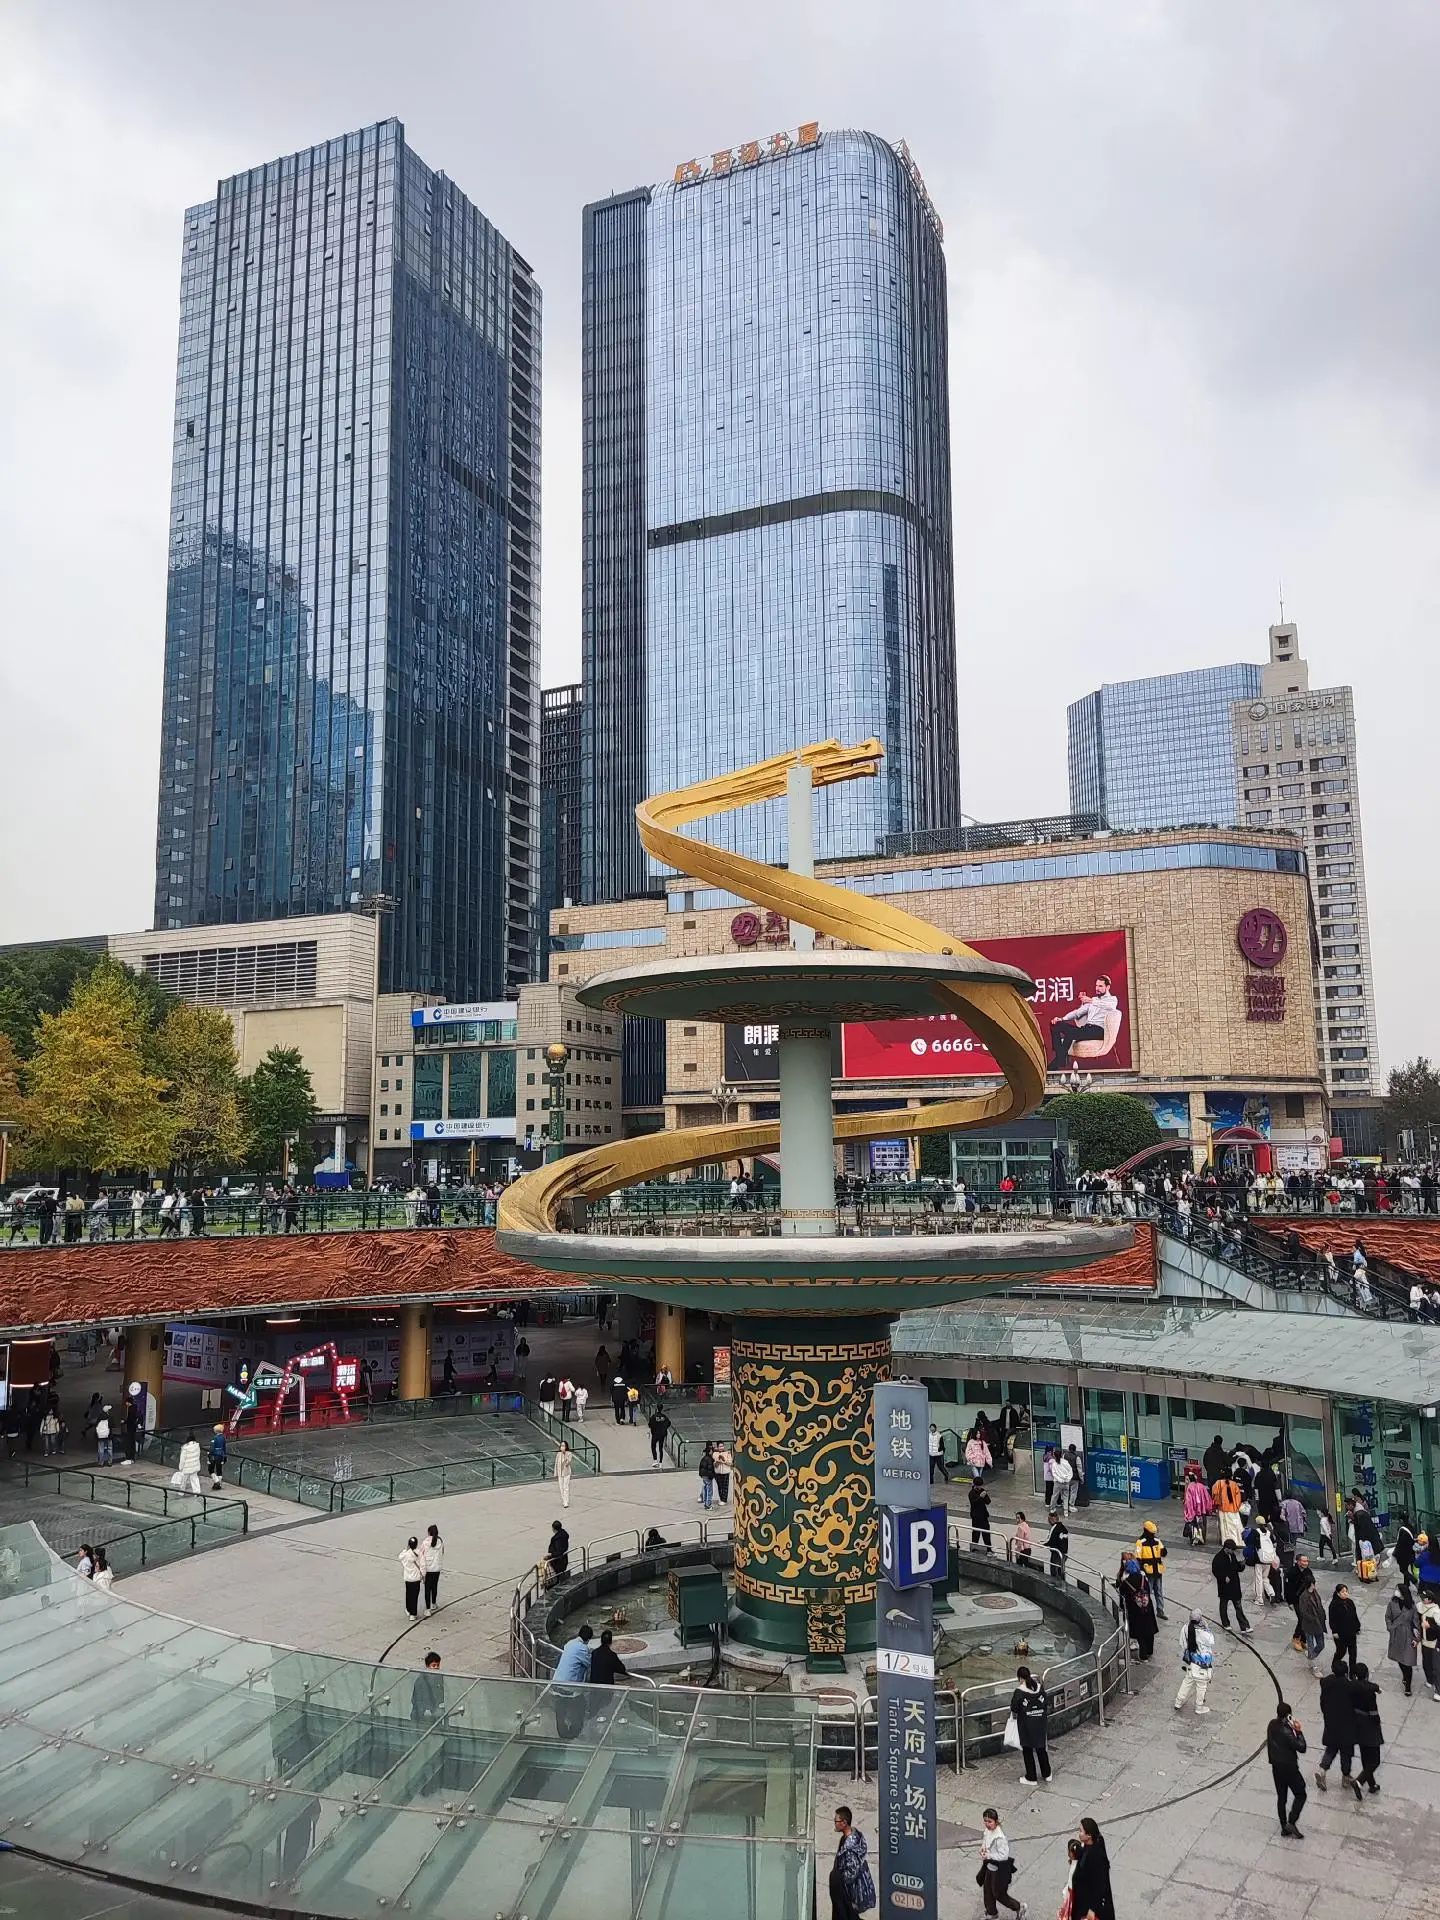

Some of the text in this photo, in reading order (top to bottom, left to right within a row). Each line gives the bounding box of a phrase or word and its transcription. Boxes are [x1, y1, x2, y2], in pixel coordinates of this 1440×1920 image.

[1275, 694, 1336, 714] 国家电网
[443, 1007, 488, 1015] 中国建设银行
[931, 1038, 990, 1053] 6666-
[446, 1121, 490, 1129] 中国建设银行
[890, 1408, 912, 1460] 地铁
[882, 1468, 921, 1480] METRO
[882, 1512, 893, 1570] B
[910, 1520, 937, 1575] B
[886, 1696, 901, 1854] Tianfu Square Station
[903, 1699, 928, 1841] 天府广场站
